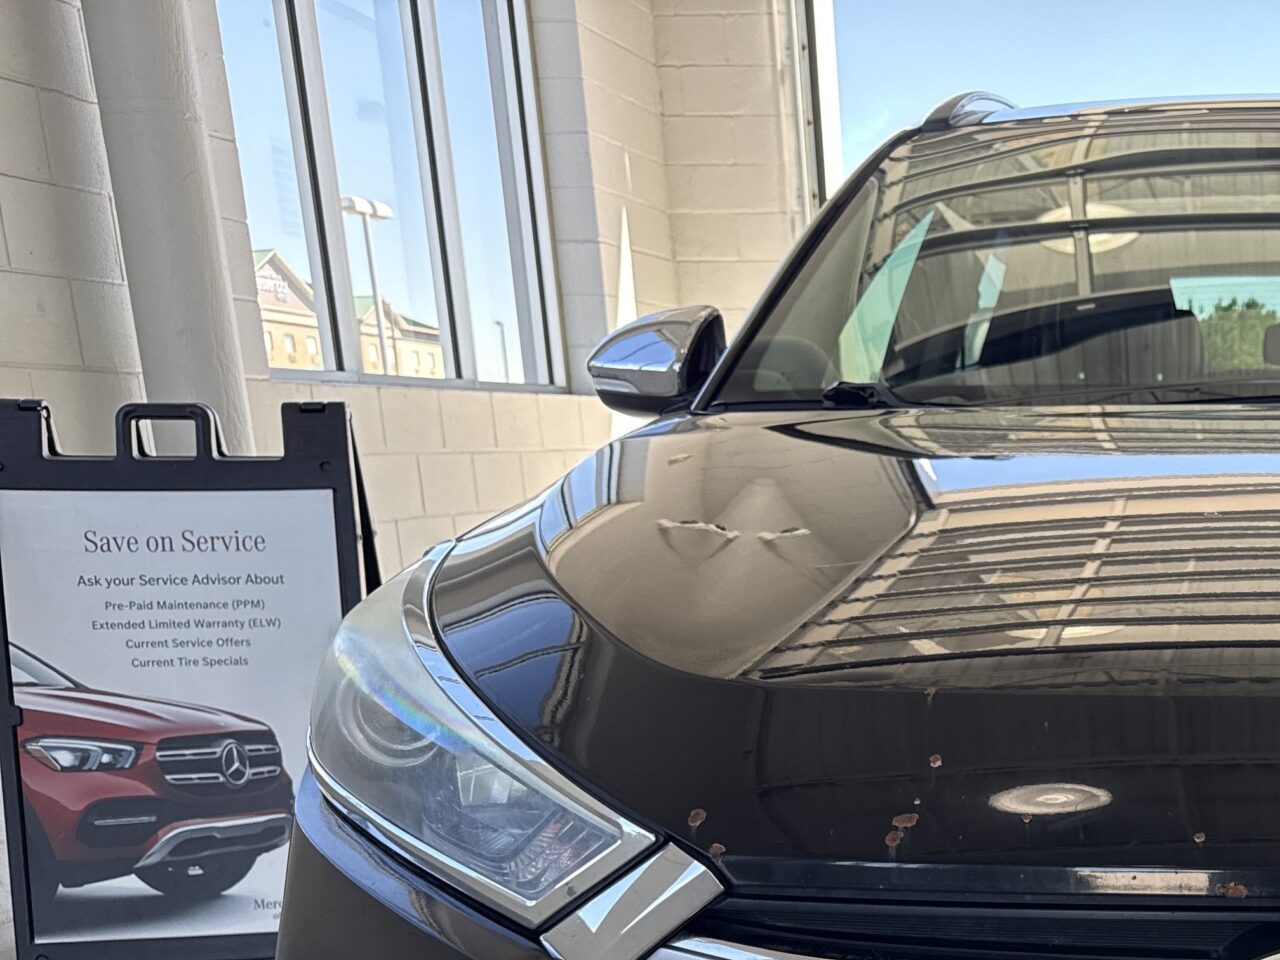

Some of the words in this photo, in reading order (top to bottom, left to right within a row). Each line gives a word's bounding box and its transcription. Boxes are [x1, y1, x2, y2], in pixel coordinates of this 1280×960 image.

[84, 529, 139, 553] Save
[146, 535, 175, 553] on
[181, 529, 266, 553] Service
[77, 575, 102, 587] Ask
[104, 577, 136, 589] your
[138, 574, 188, 586] Service
[191, 573, 241, 586] Advisor
[245, 573, 285, 585] About
[104, 601, 154, 611] Pre-Paid
[156, 600, 229, 610] Maintenance
[231, 599, 265, 611] (PPM)
[91, 620, 146, 630] Extended
[148, 619, 191, 629] Limited
[193, 619, 246, 630] Warranty
[248, 618, 282, 630] (ELW)
[125, 639, 169, 649] Current
[171, 637, 214, 648] Service
[216, 637, 252, 648] Offers
[131, 658, 175, 668] Current
[177, 656, 200, 667] Tire
[202, 656, 249, 668] Specials
